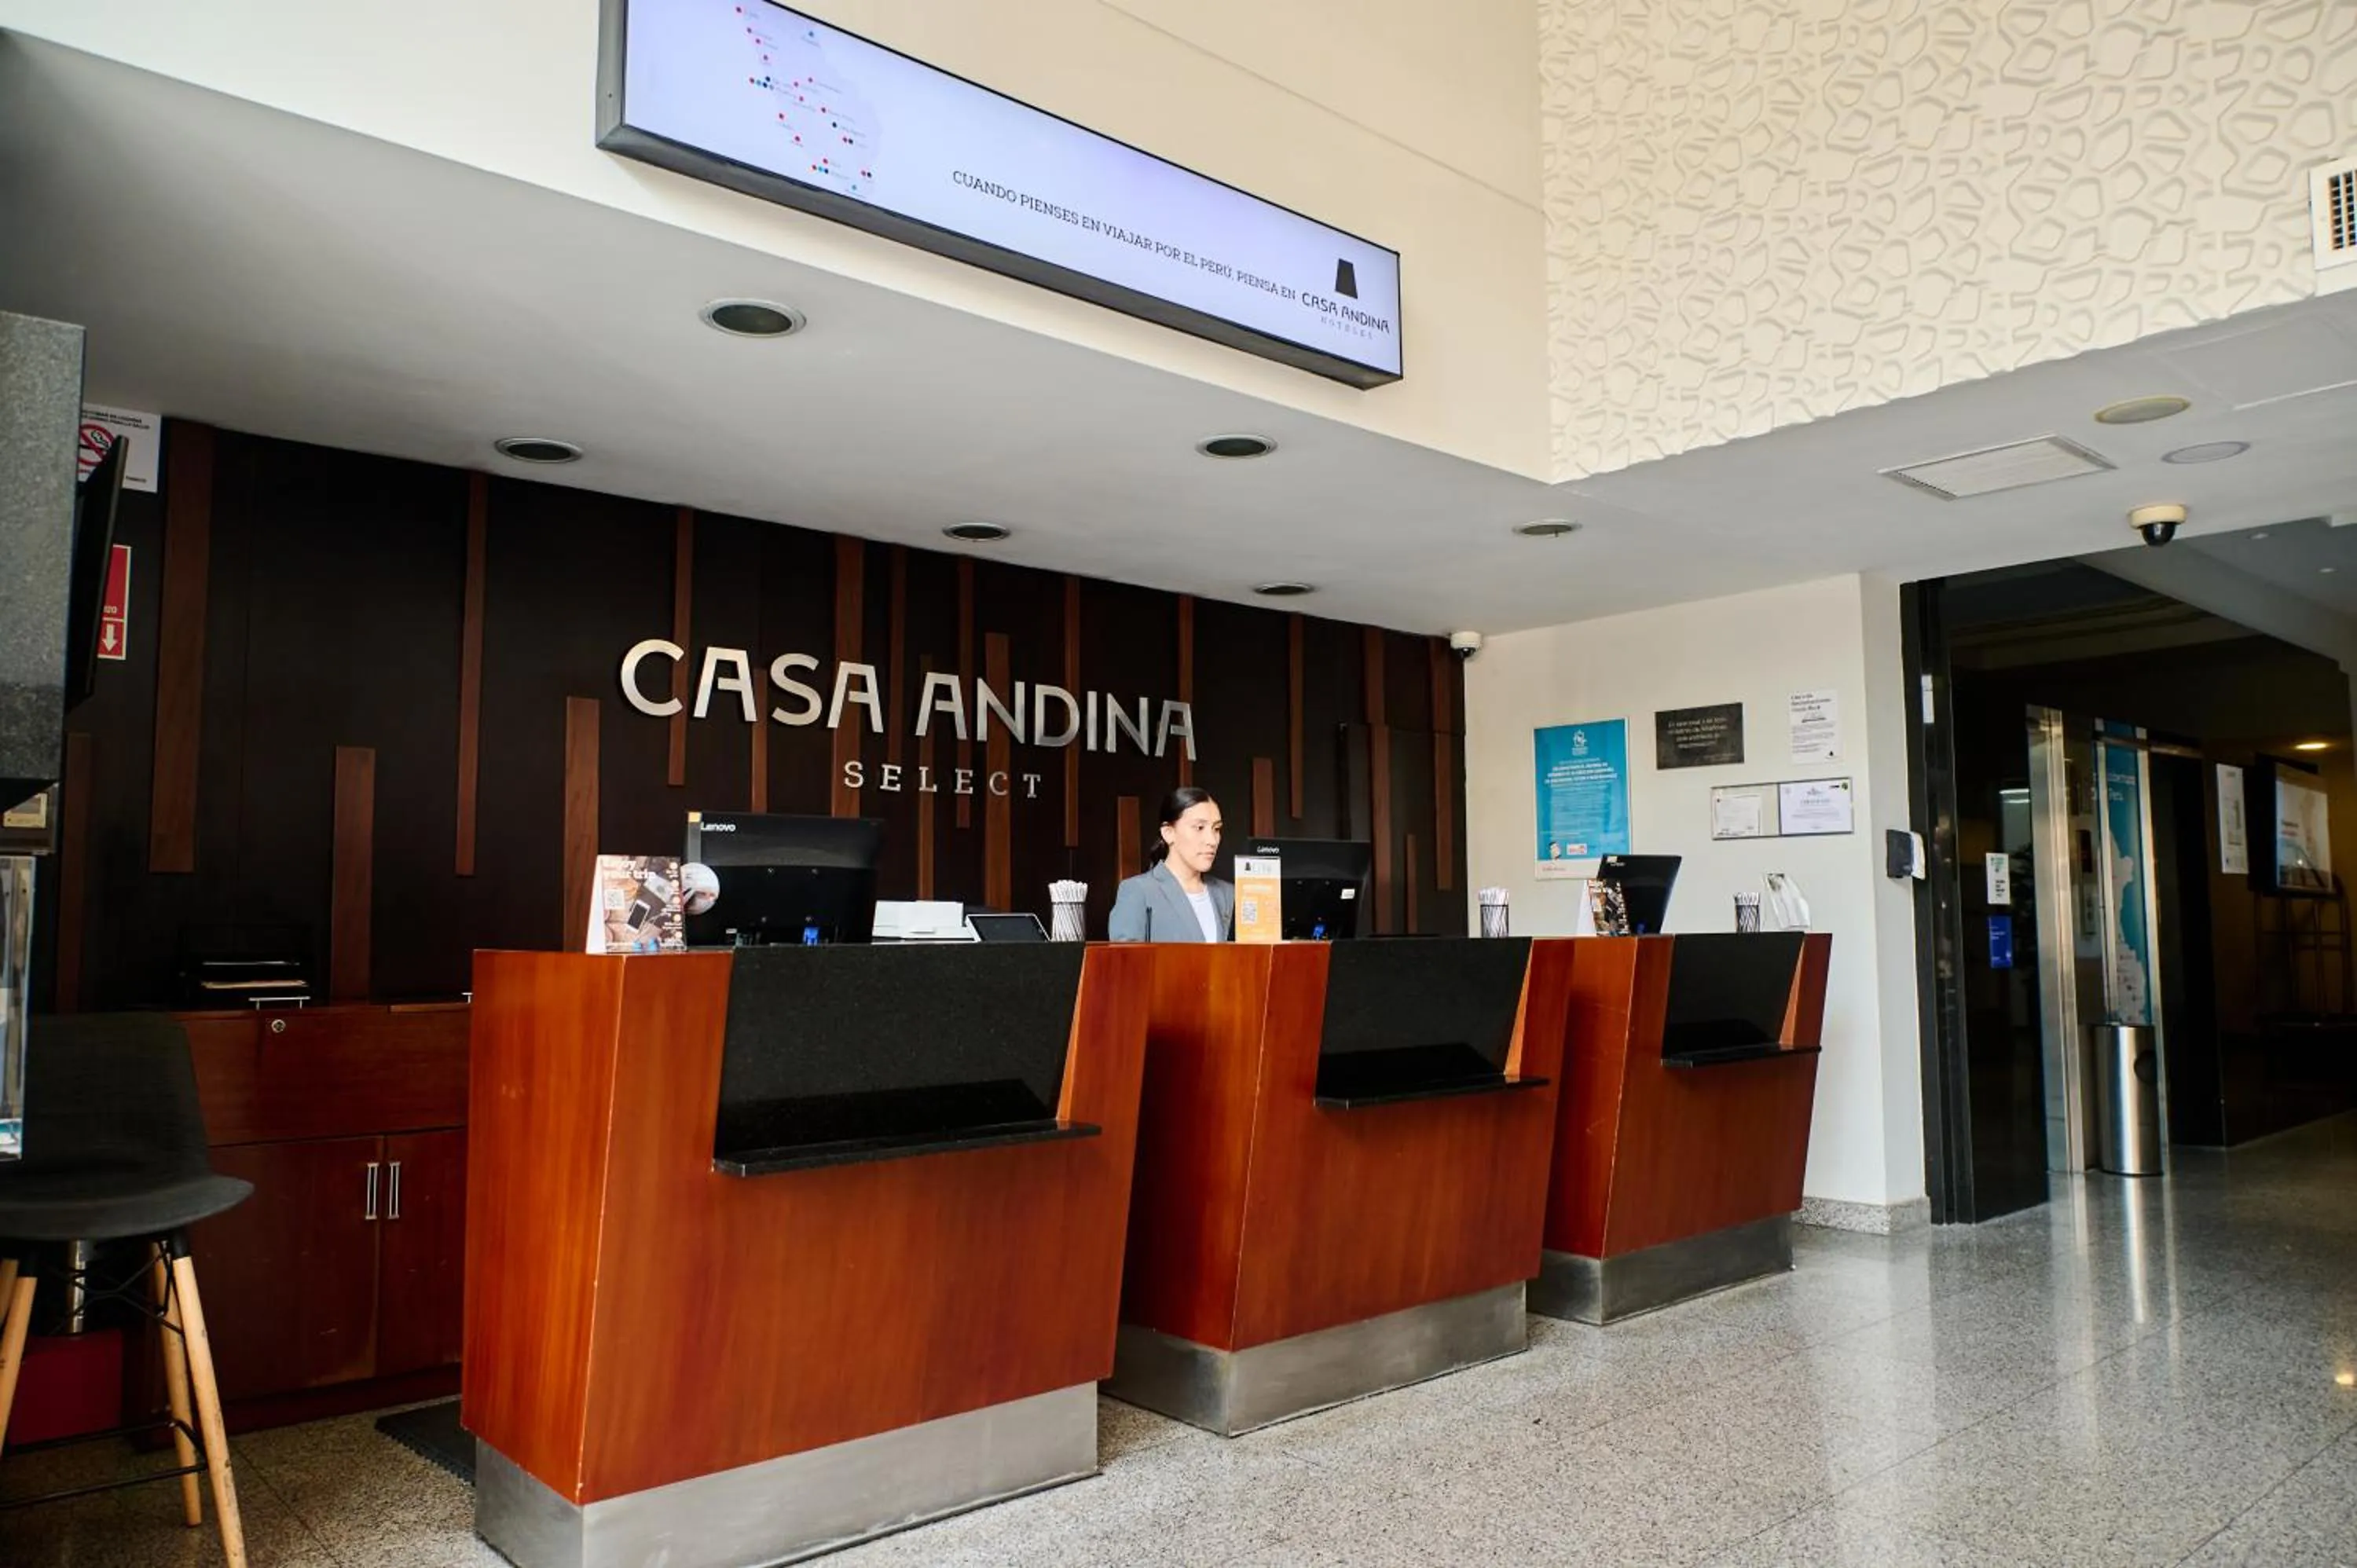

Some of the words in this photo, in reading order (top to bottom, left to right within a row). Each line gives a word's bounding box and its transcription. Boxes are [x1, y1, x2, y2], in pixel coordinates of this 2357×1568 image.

[952, 170, 1017, 203] CUANDO
[1020, 193, 1080, 225] PIENSES
[1082, 215, 1101, 232] EN
[1102, 222, 1153, 251] VIAJAR
[1155, 241, 1181, 262] POR
[1183, 251, 1198, 267] EL
[1237, 269, 1279, 296] PIENSA
[1281, 286, 1296, 300] EN
[1302, 291, 1338, 317] CASA
[1341, 305, 1390, 334] ANDINA
[619, 638, 885, 734] CASA
[915, 671, 1197, 762] ANDINA
[843, 760, 1042, 799] SELECT
[700, 821, 736, 832] Lenovo
